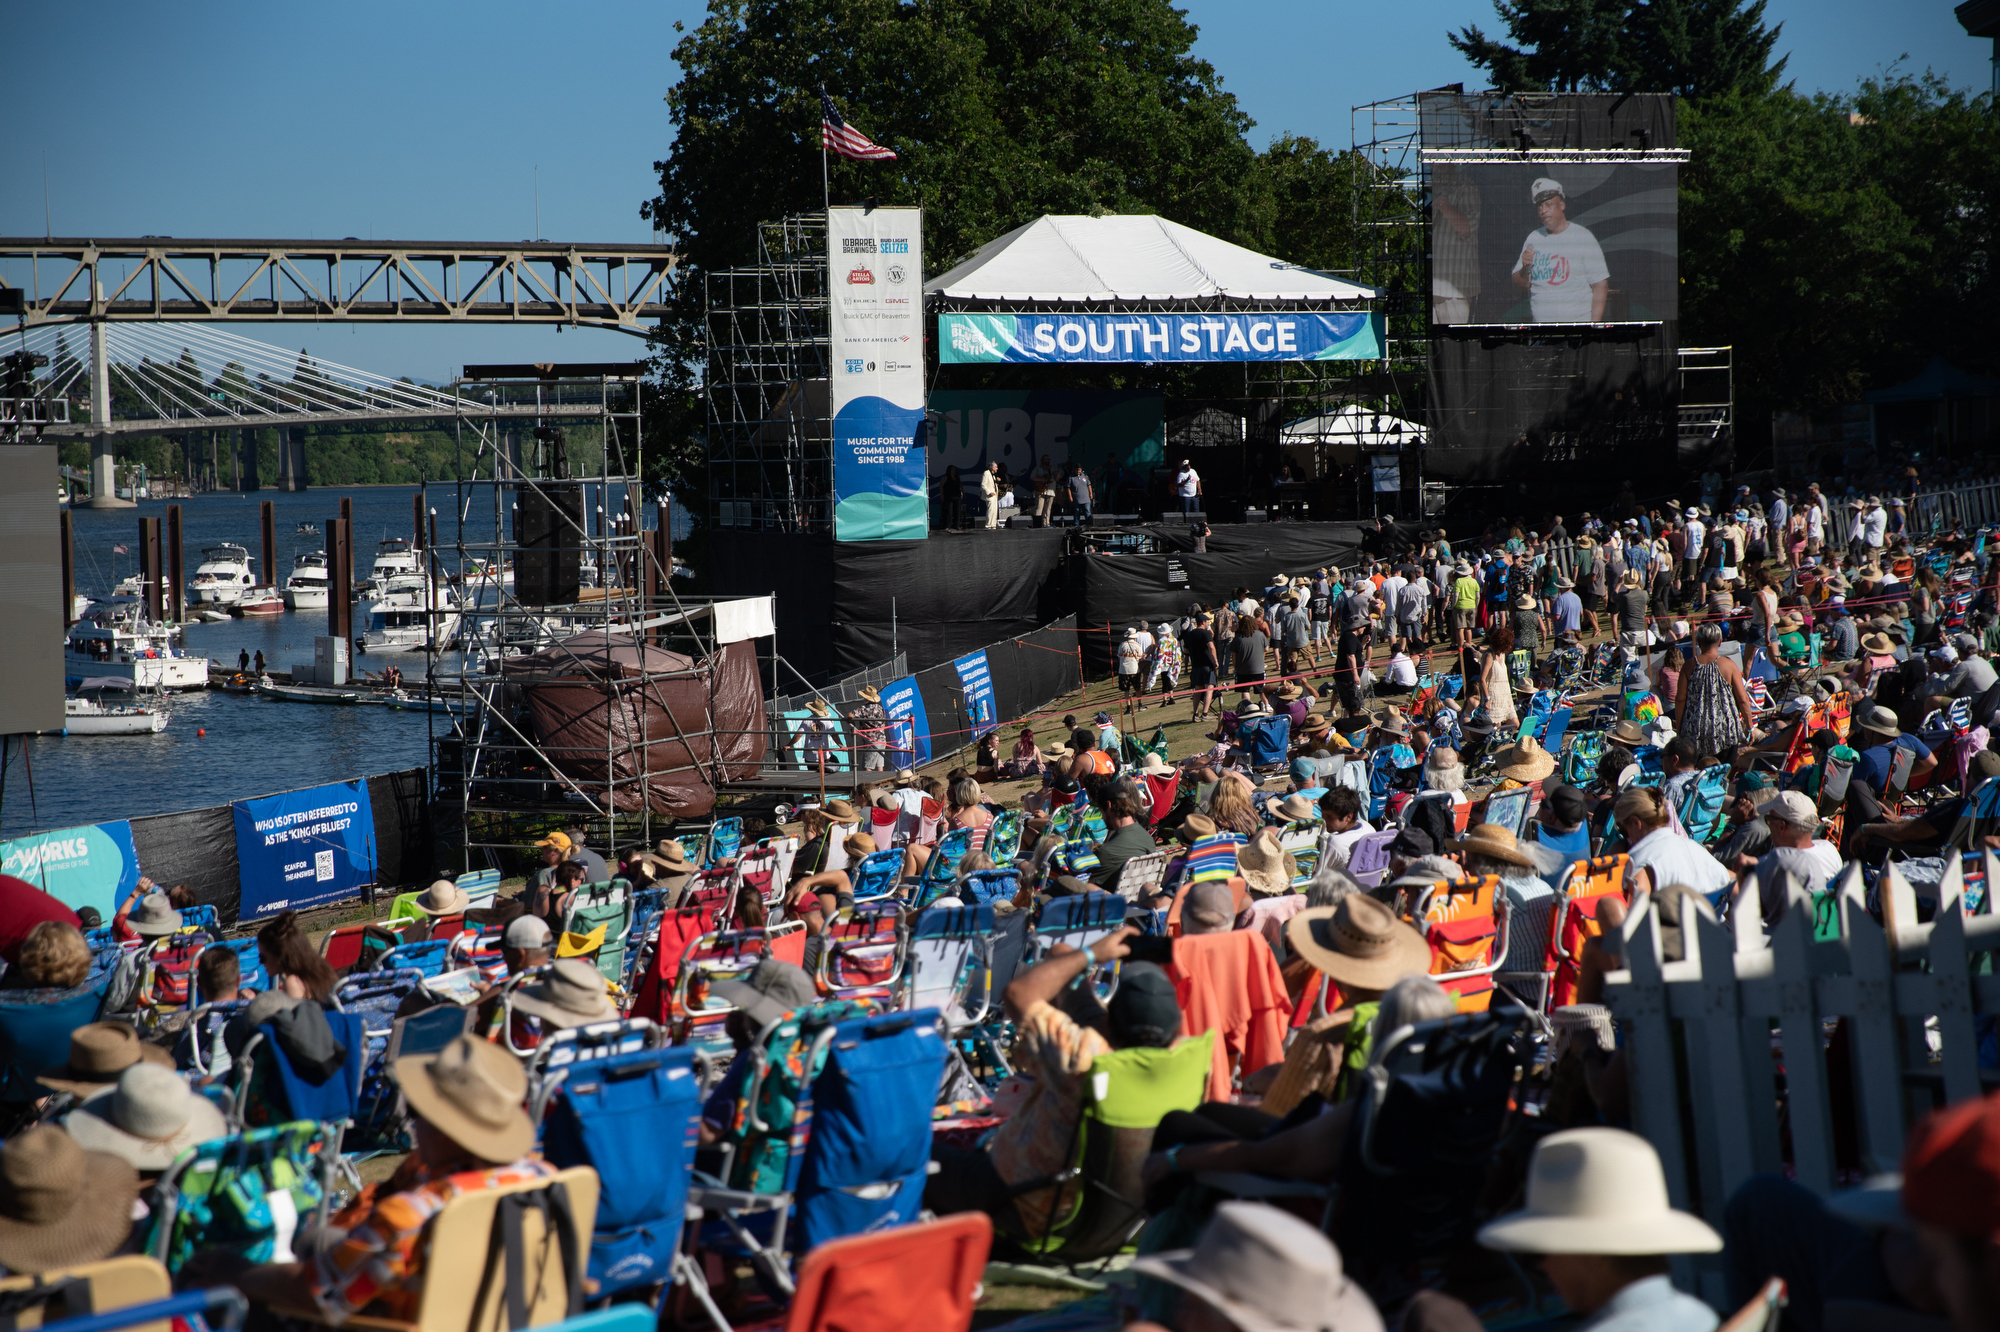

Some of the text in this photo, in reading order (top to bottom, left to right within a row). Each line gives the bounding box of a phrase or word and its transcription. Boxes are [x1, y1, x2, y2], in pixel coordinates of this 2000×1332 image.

[842, 238, 877, 247] 10 BARREL
[842, 246, 869, 254] BREWING
[880, 243, 909, 254] SELTZER
[1033, 321, 1298, 354] SOUTH STAGE
[854, 364, 863, 373] 6
[847, 437, 914, 446] MUSIC FOR THE
[853, 446, 909, 455] COMMUNITY
[857, 455, 905, 464] SINCE 1988
[254, 802, 358, 832] WHO IS OFTEN REFERRED TO
[264, 834, 275, 847] AS
[275, 830, 288, 844] THE
[311, 823, 320, 835] OF
[45, 861, 70, 872] PARTNER
[70, 860, 78, 868] OF
[78, 858, 90, 867] THE
[284, 860, 307, 873] SCAN FOR
